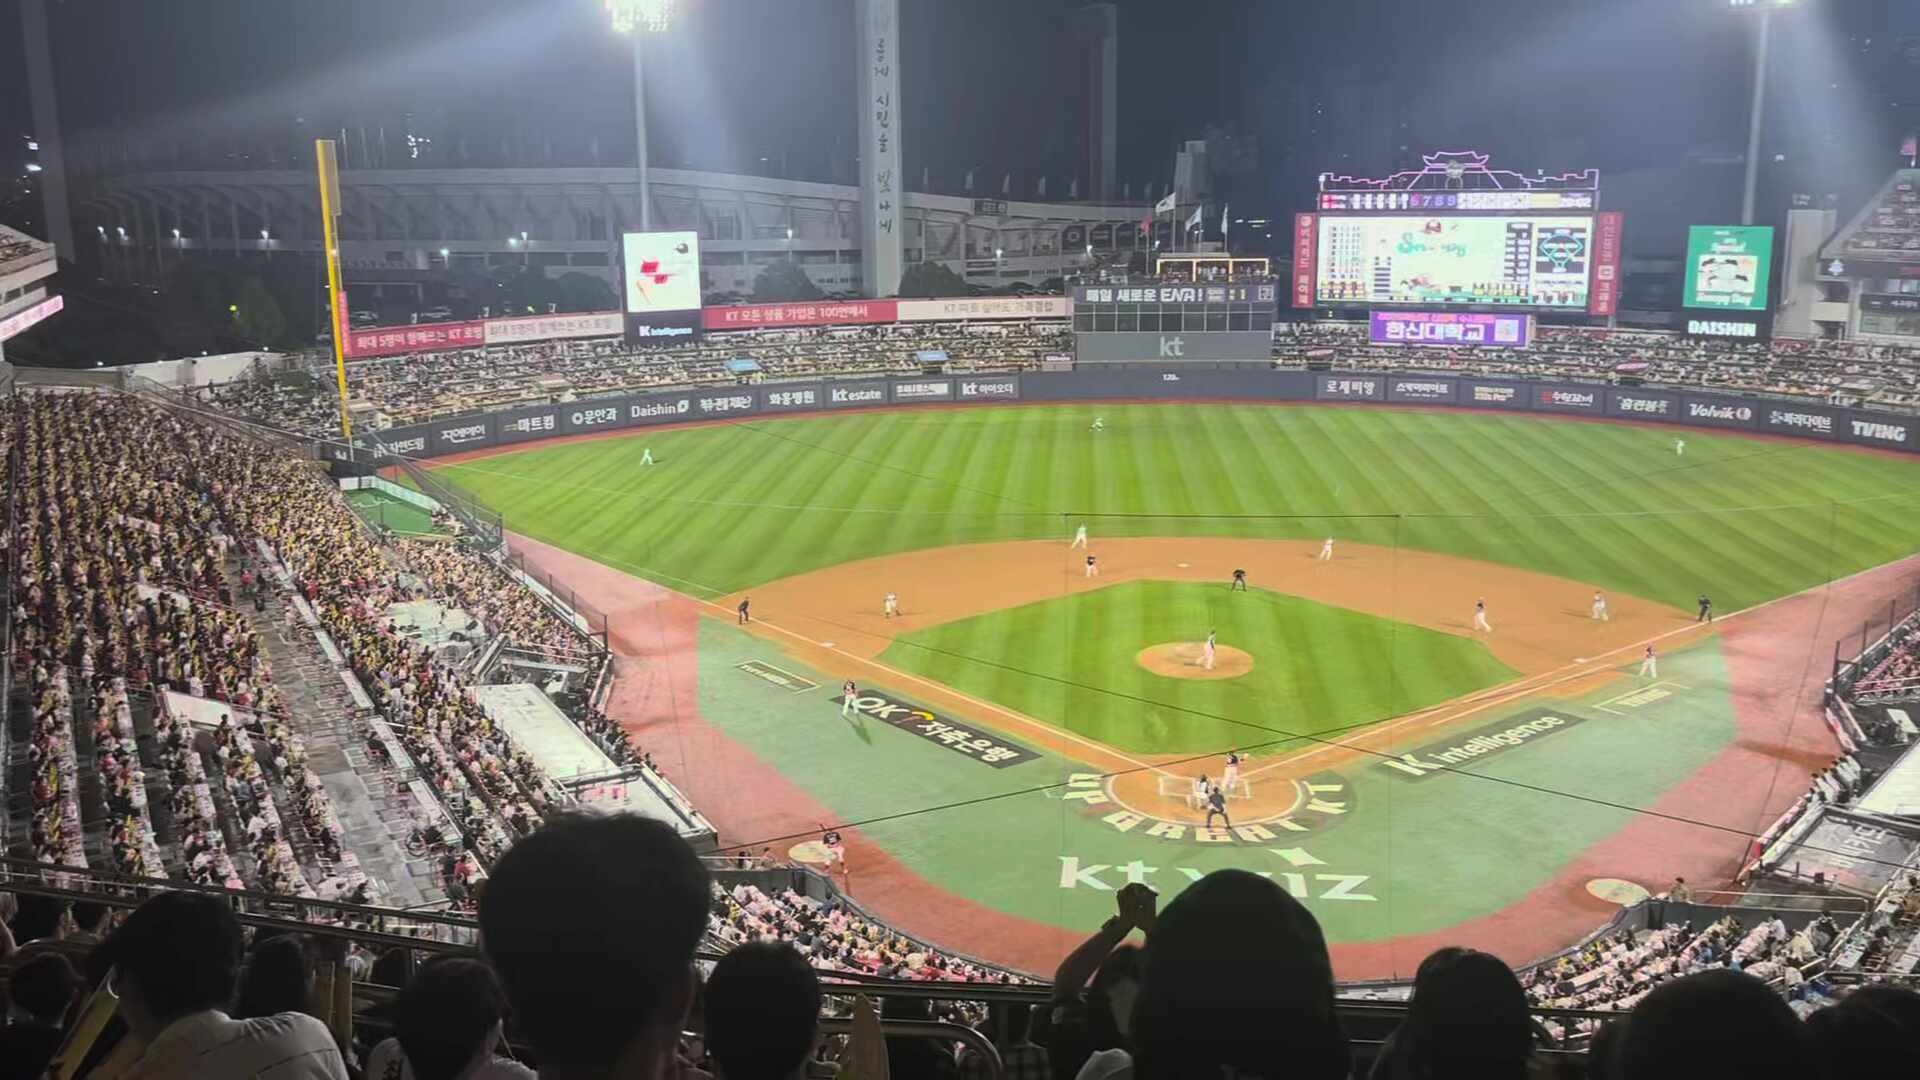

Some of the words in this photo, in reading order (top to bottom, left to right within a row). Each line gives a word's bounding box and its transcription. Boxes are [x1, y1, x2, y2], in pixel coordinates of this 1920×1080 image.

[1688, 320, 1757, 337] DAISHIN
[1160, 336, 1184, 356] kt
[831, 388, 848, 402] kt
[848, 389, 882, 401] estate
[631, 403, 677, 418] Daishin
[1688, 403, 1737, 421] Volvik
[1851, 420, 1906, 442] TVING
[853, 697, 910, 721] OK
[1436, 715, 1566, 764] intelligence
